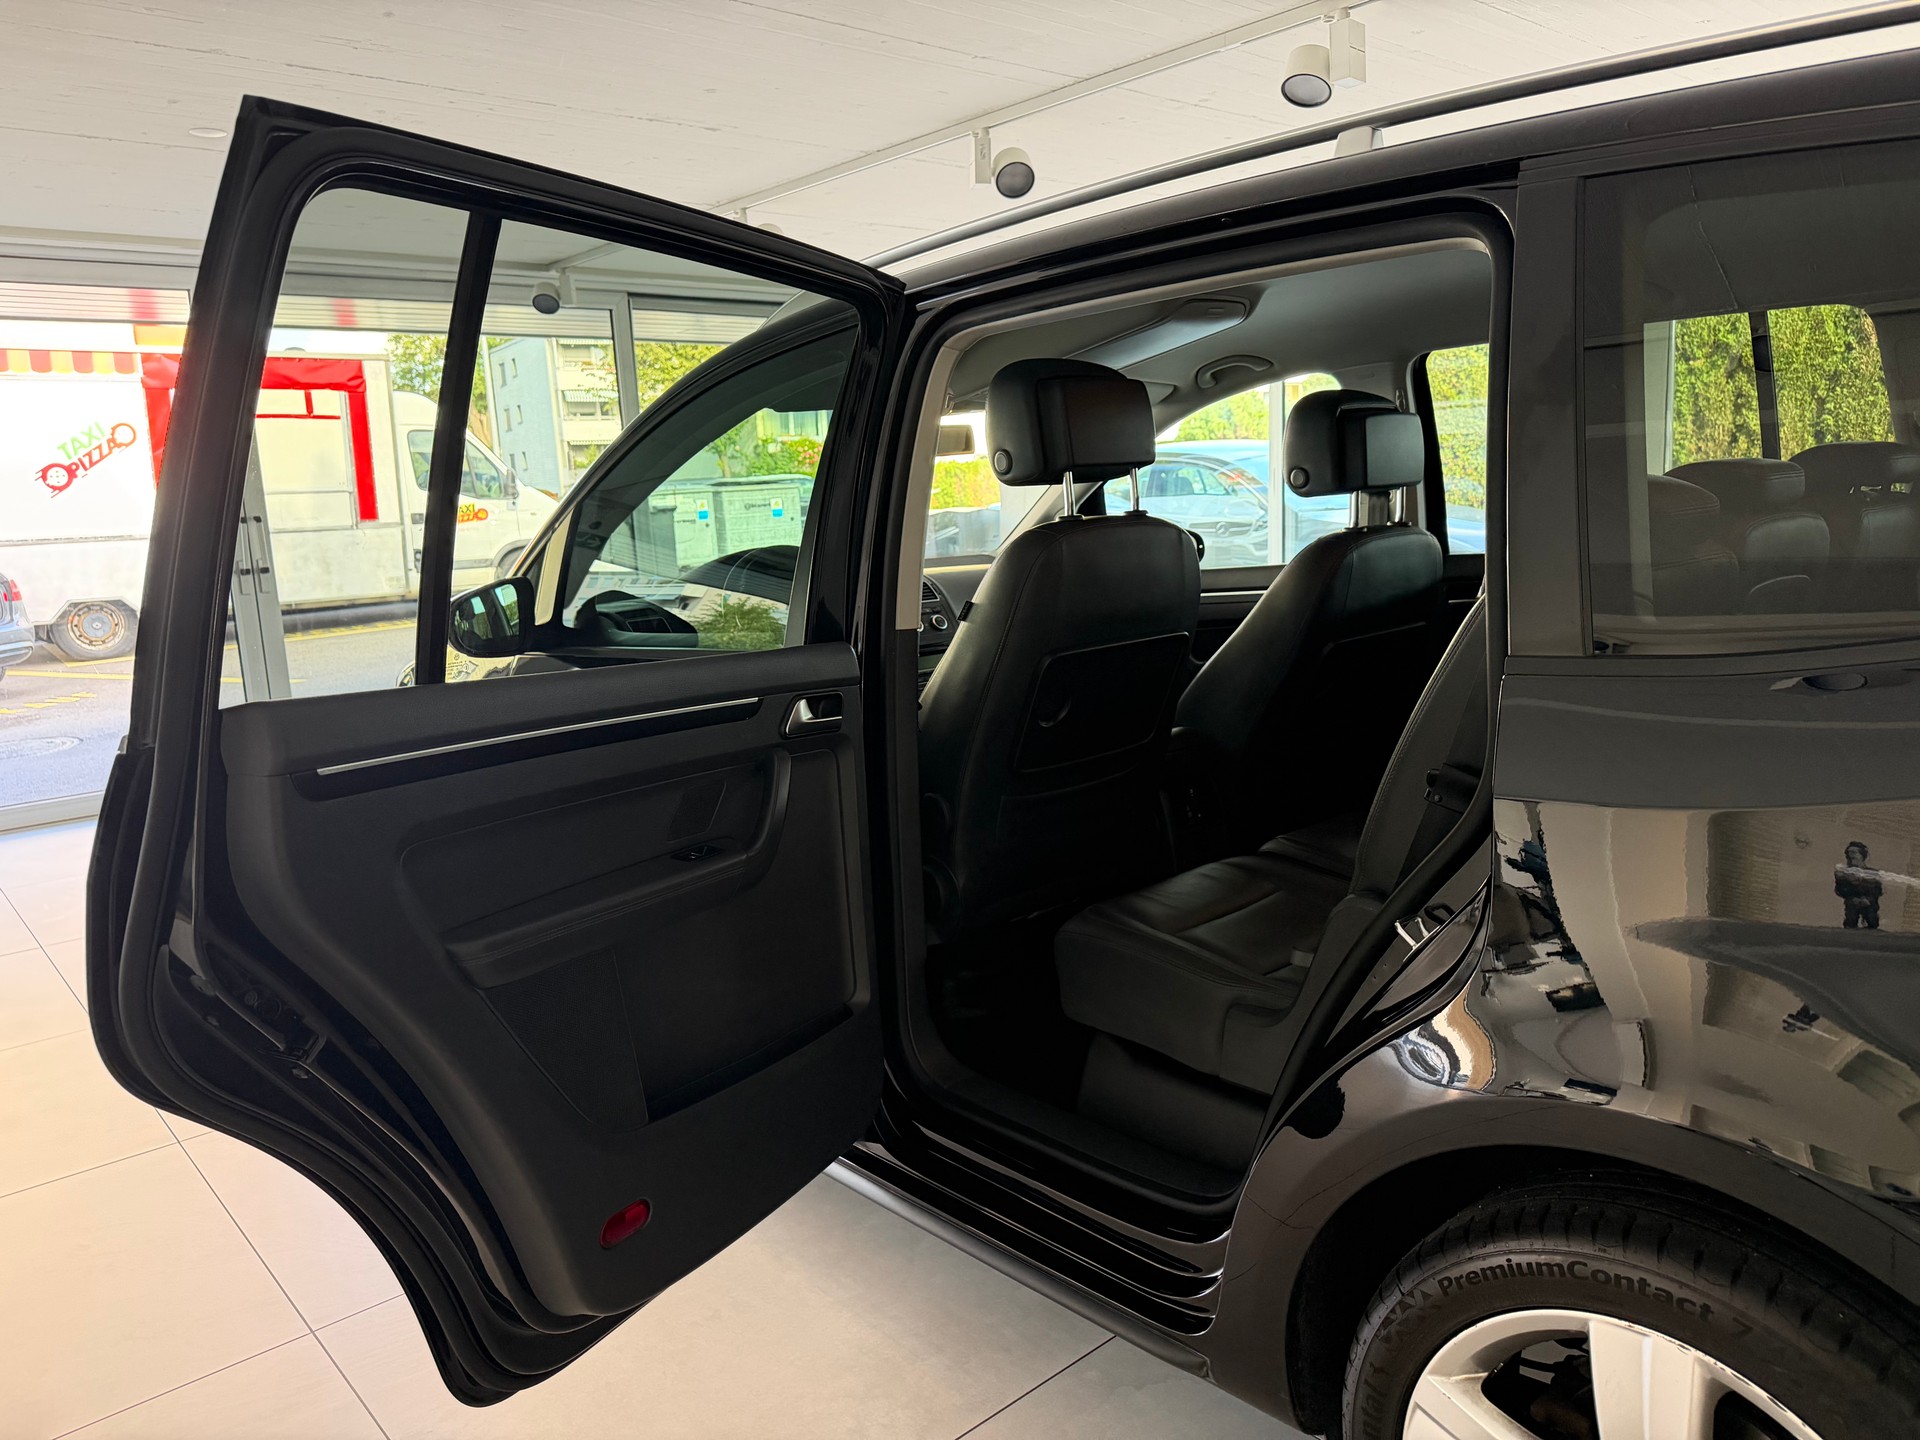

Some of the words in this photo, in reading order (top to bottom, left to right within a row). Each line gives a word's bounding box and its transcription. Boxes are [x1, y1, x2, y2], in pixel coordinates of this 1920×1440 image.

[57, 421, 105, 460] TAXI
[68, 438, 117, 478] PIZZA
[459, 503, 475, 514] AXI
[1437, 1258, 1714, 1322] PremiumContact
[1731, 1316, 1754, 1337] 7
